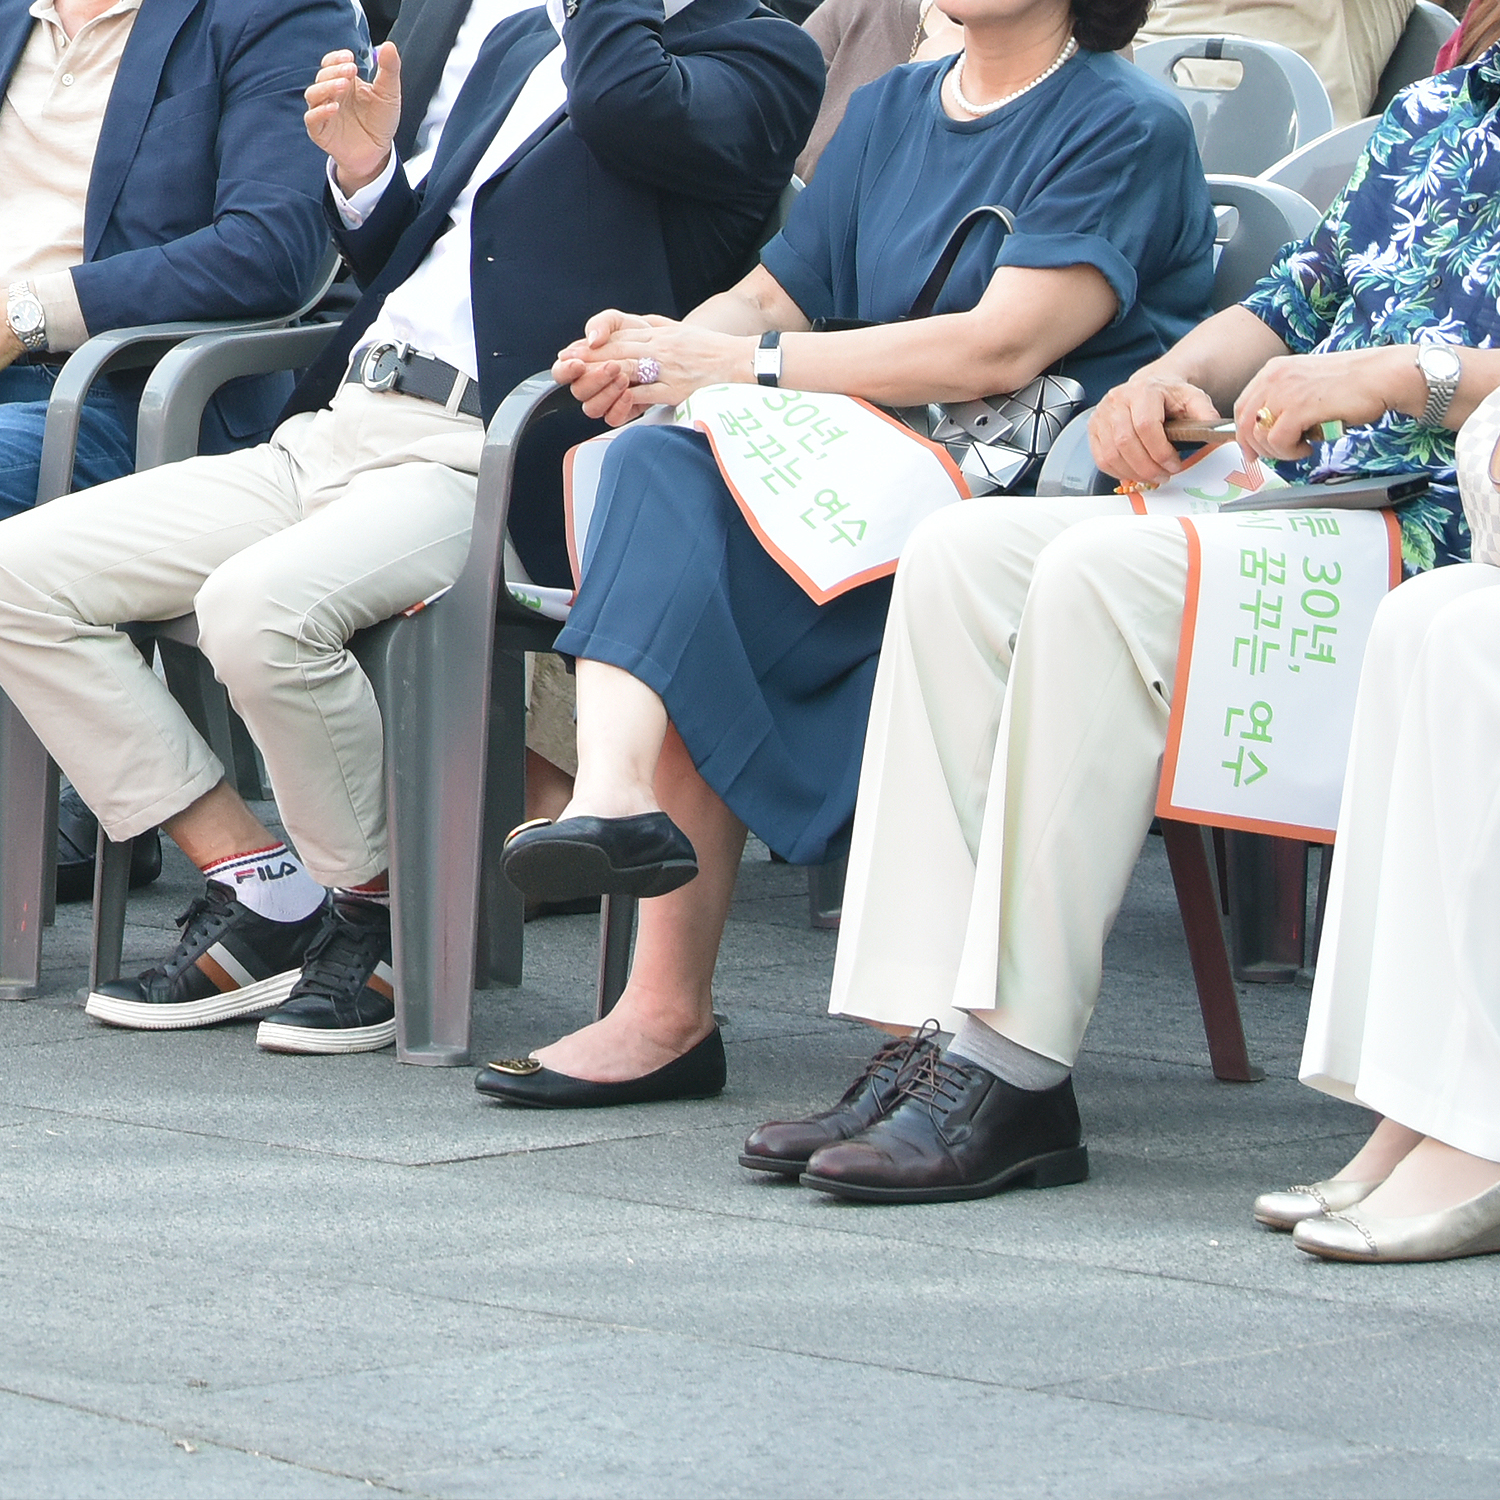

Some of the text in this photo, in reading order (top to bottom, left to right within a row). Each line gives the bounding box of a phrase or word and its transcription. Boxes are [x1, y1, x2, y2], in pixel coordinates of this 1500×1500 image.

[717, 408, 868, 548] 꿈꾸는 연수
[1232, 547, 1286, 675] 꿈꾸는
[1287, 556, 1342, 673] 30년,
[1221, 700, 1273, 787] 연수
[234, 861, 297, 884] FILA
